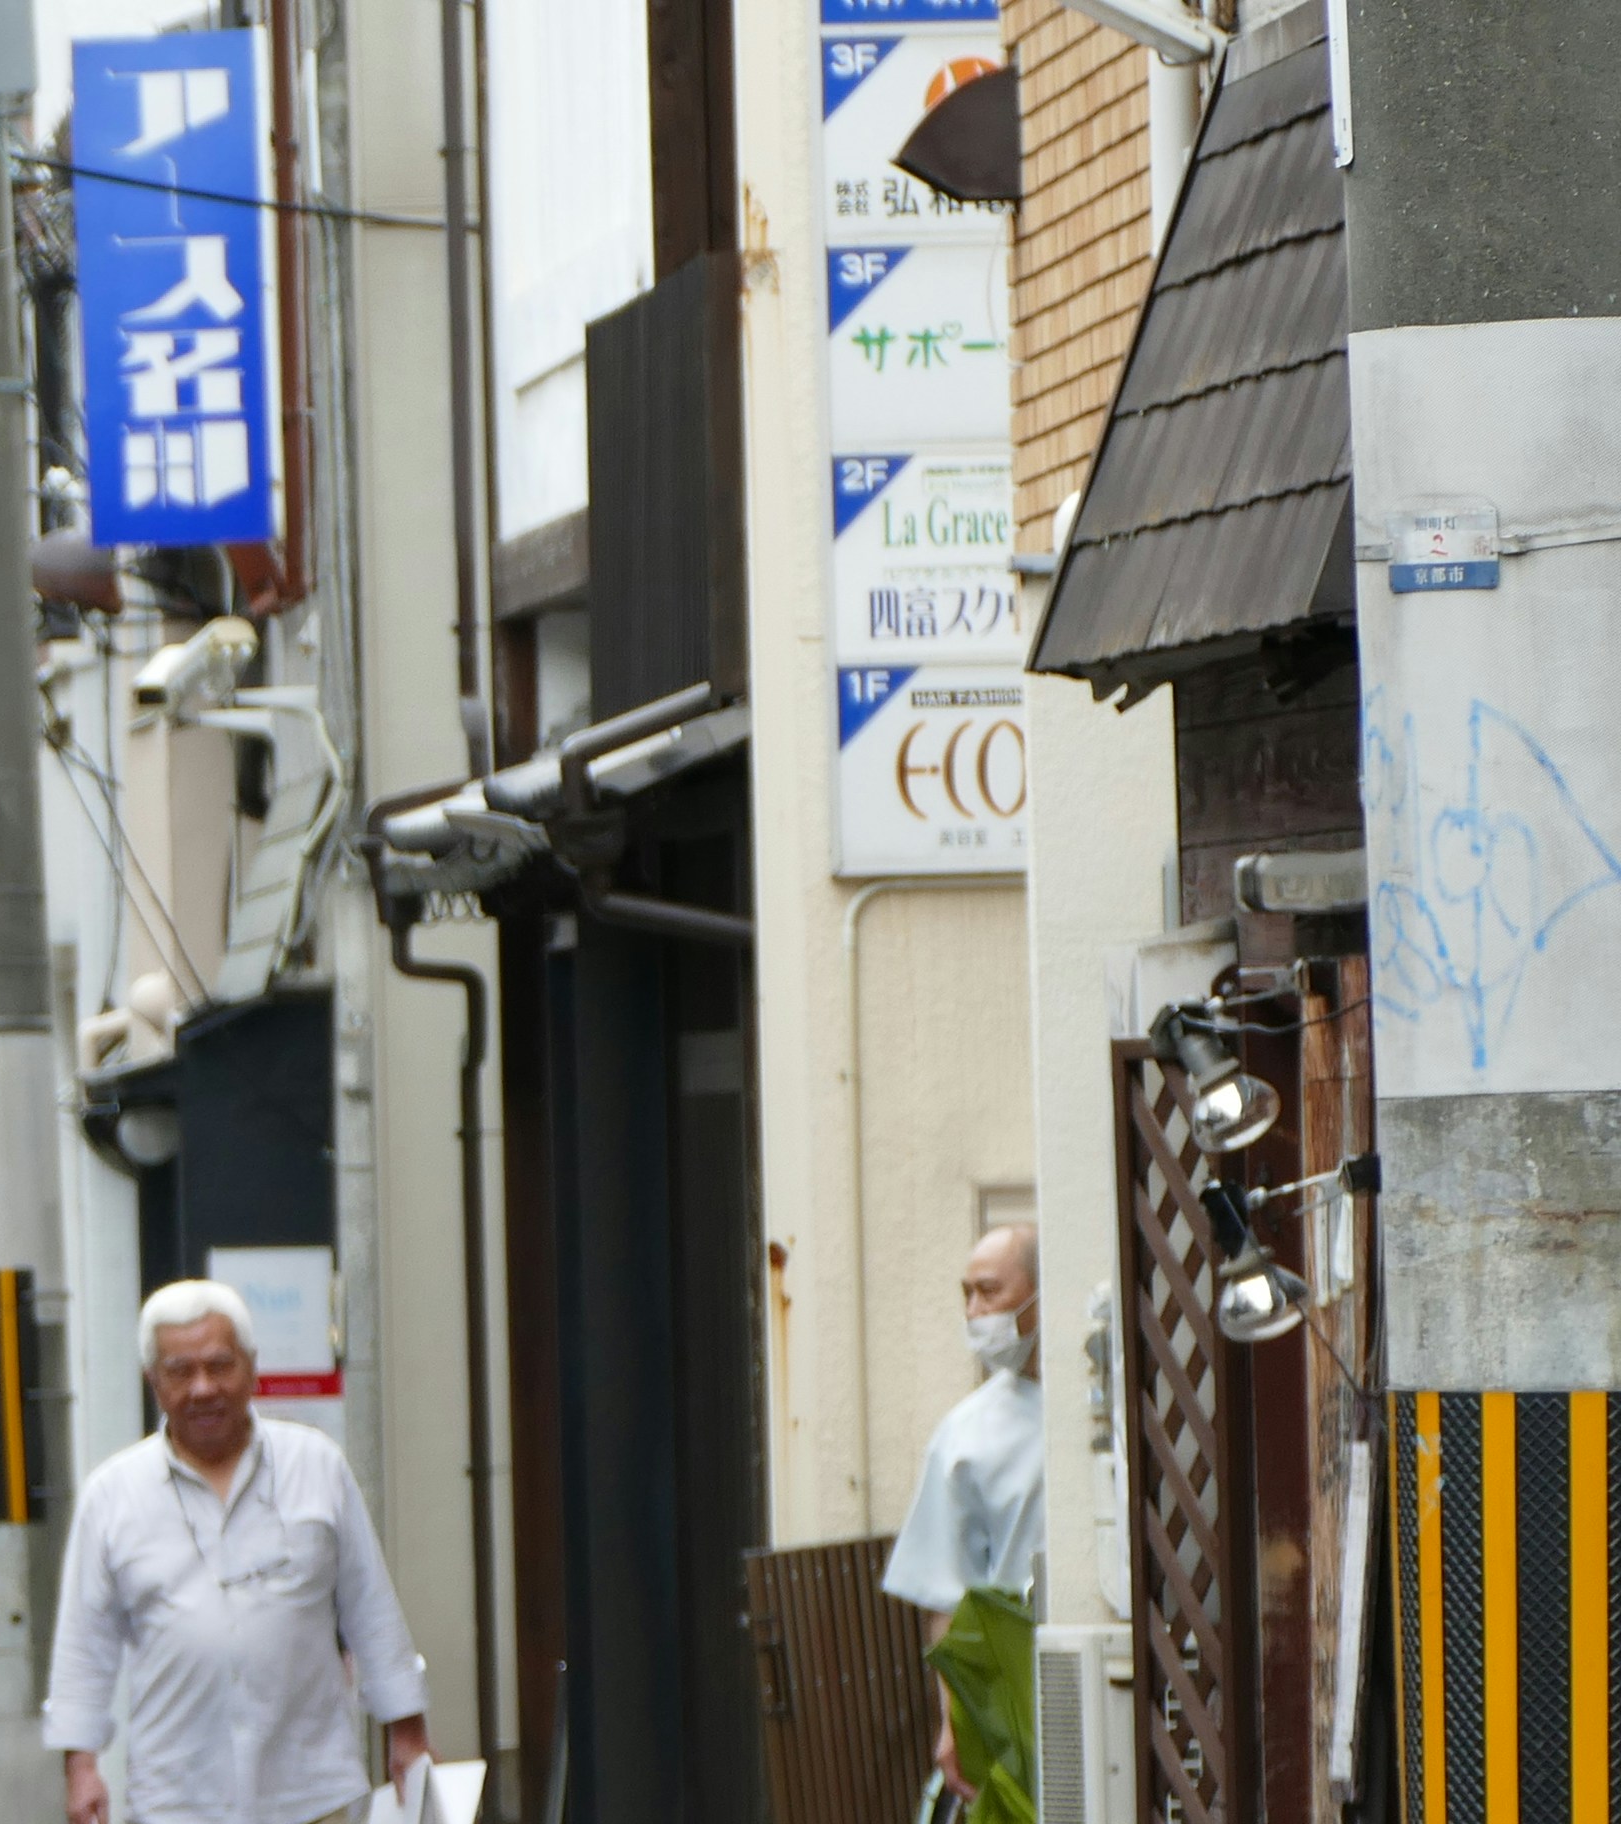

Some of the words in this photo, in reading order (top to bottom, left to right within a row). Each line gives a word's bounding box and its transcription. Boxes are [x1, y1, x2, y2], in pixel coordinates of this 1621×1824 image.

[831, 43, 878, 77] 3F
[840, 252, 888, 286] 3F
[841, 458, 889, 493] 2F
[883, 499, 917, 546] La
[927, 496, 1008, 546] Grace
[848, 670, 891, 704] 1F
